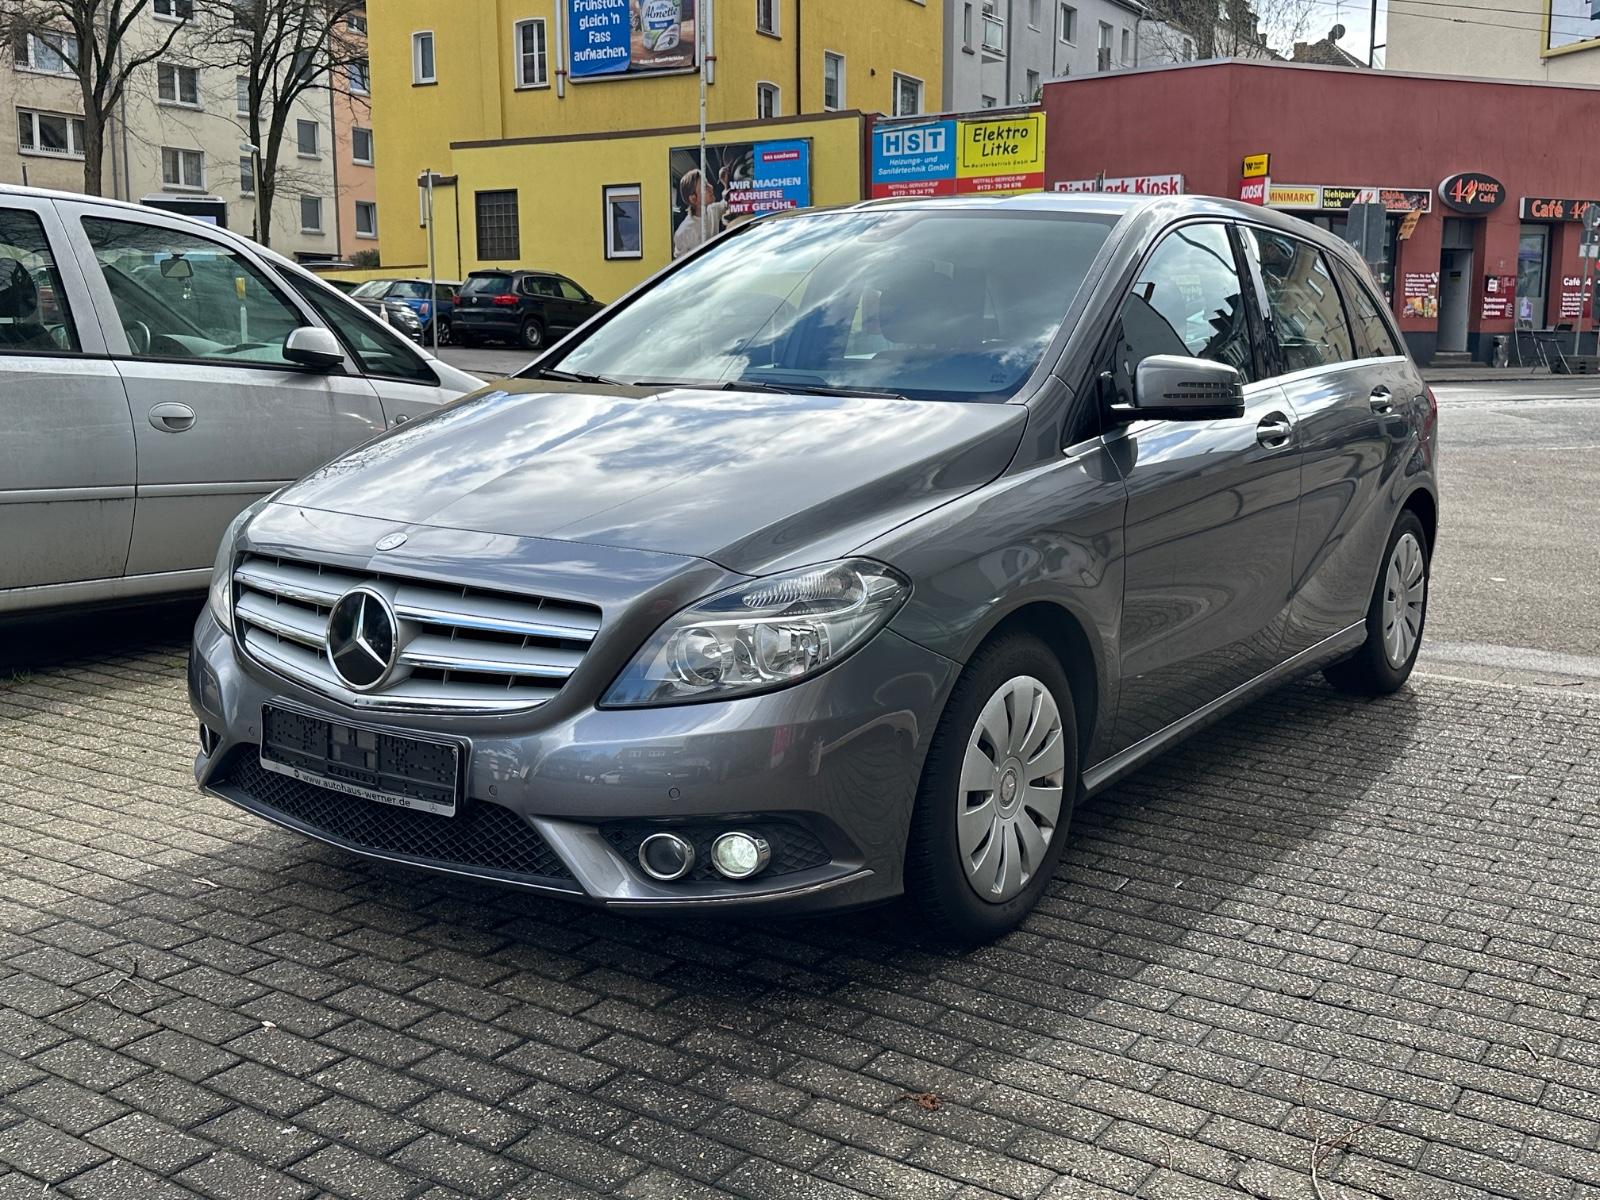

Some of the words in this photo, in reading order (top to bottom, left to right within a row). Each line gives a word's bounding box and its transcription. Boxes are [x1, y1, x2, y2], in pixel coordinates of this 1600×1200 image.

[579, 13, 608, 30] gleich
[610, 12, 620, 24] 'n
[589, 31, 611, 44] Fass
[972, 126, 1028, 142] Elektro
[885, 130, 943, 154] HST
[981, 142, 1018, 157] Litke
[928, 163, 950, 171] GmbH
[729, 180, 750, 190] WIR
[753, 177, 801, 188] MACHEN
[1135, 176, 1179, 195] Kiosk
[1478, 182, 1500, 193] KIOSK
[729, 190, 783, 201] KARRIERE
[1240, 183, 1264, 200] KIOSK
[1269, 192, 1315, 203] MINIMARKT
[1324, 189, 1356, 200] Riehlpark
[1479, 192, 1496, 203] Café
[730, 203, 750, 213] MIT
[1323, 199, 1342, 208] kiosk
[1531, 200, 1563, 218] Café
[1563, 277, 1580, 286] Café
[302, 773, 411, 807] www.autohaus-werner.de
